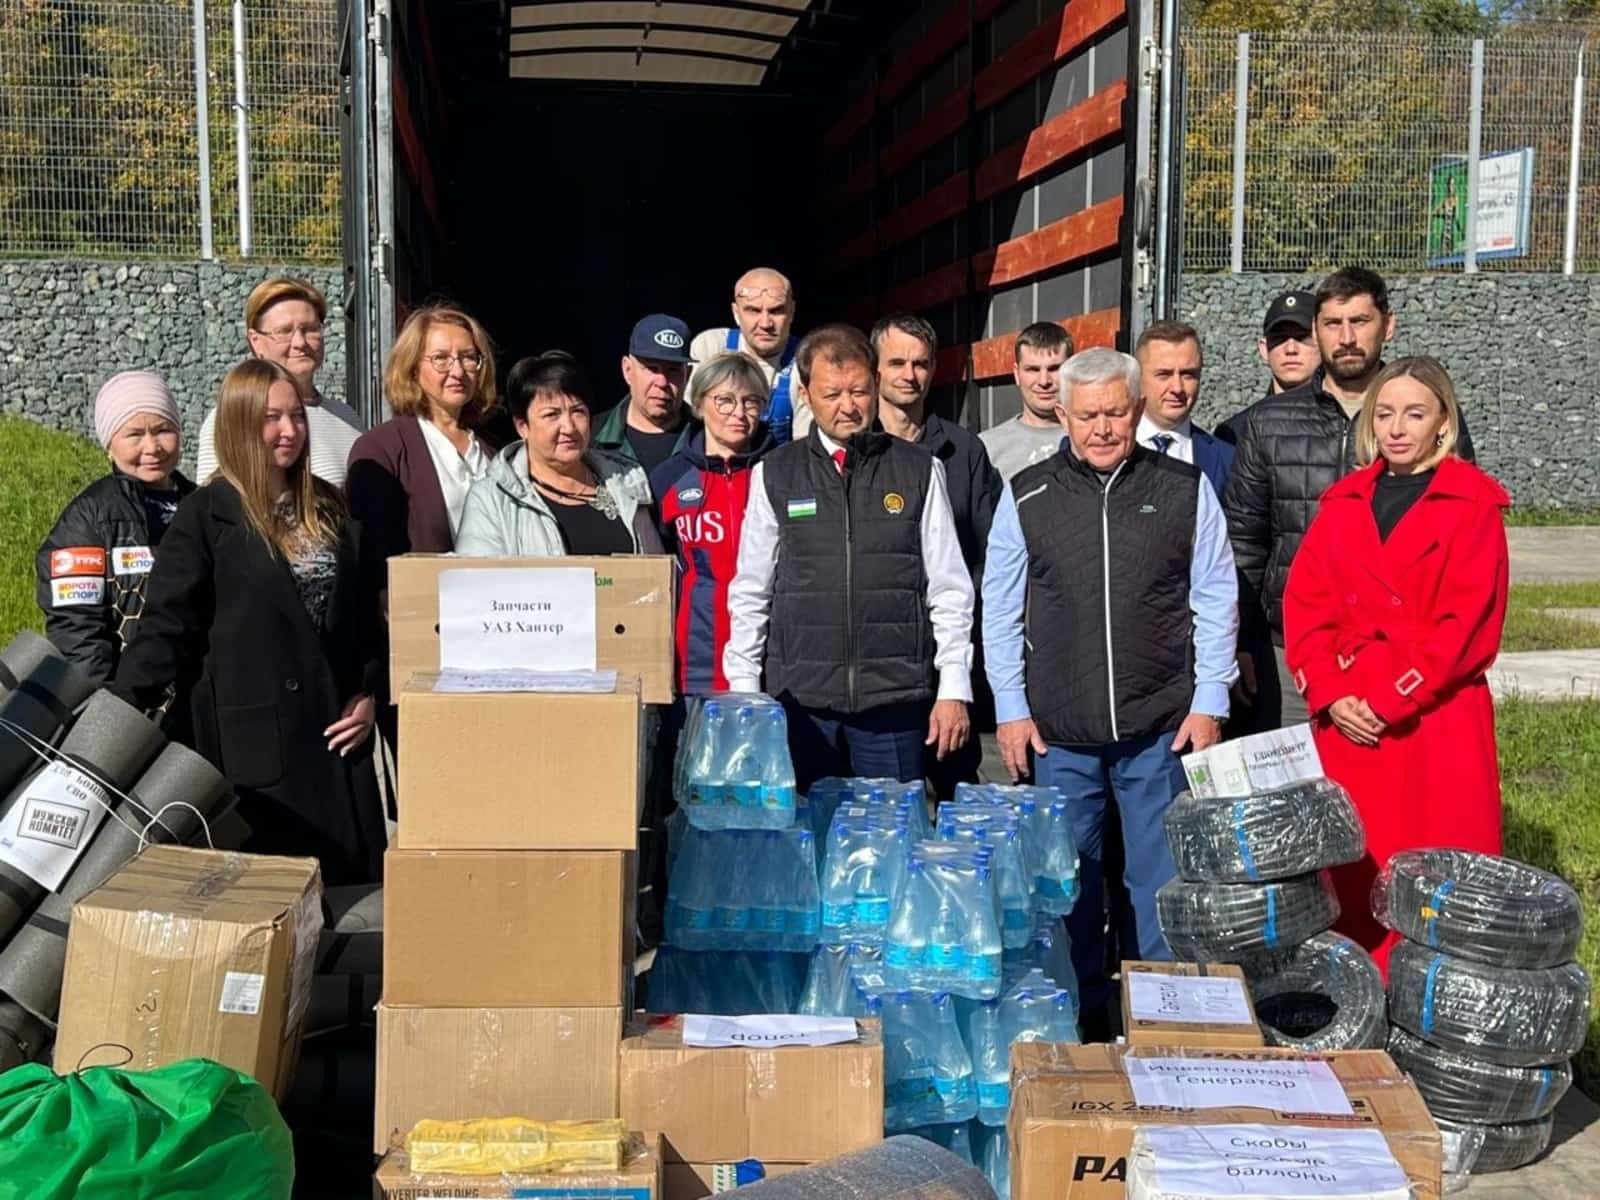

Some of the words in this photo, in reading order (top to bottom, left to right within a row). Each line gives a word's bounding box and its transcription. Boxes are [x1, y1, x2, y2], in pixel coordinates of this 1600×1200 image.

[675, 511, 724, 543] RUS
[67, 591, 100, 600] СПОРТ
[490, 600, 551, 612] Запчасти
[482, 622, 511, 633] УАЗ
[516, 621, 564, 636] Хантер
[32, 808, 79, 828] МУЖСКОЙ
[28, 819, 75, 840] КОМИТЕТ
[1175, 1074, 1296, 1089] Генератор
[1230, 1137, 1306, 1149] Скобы
